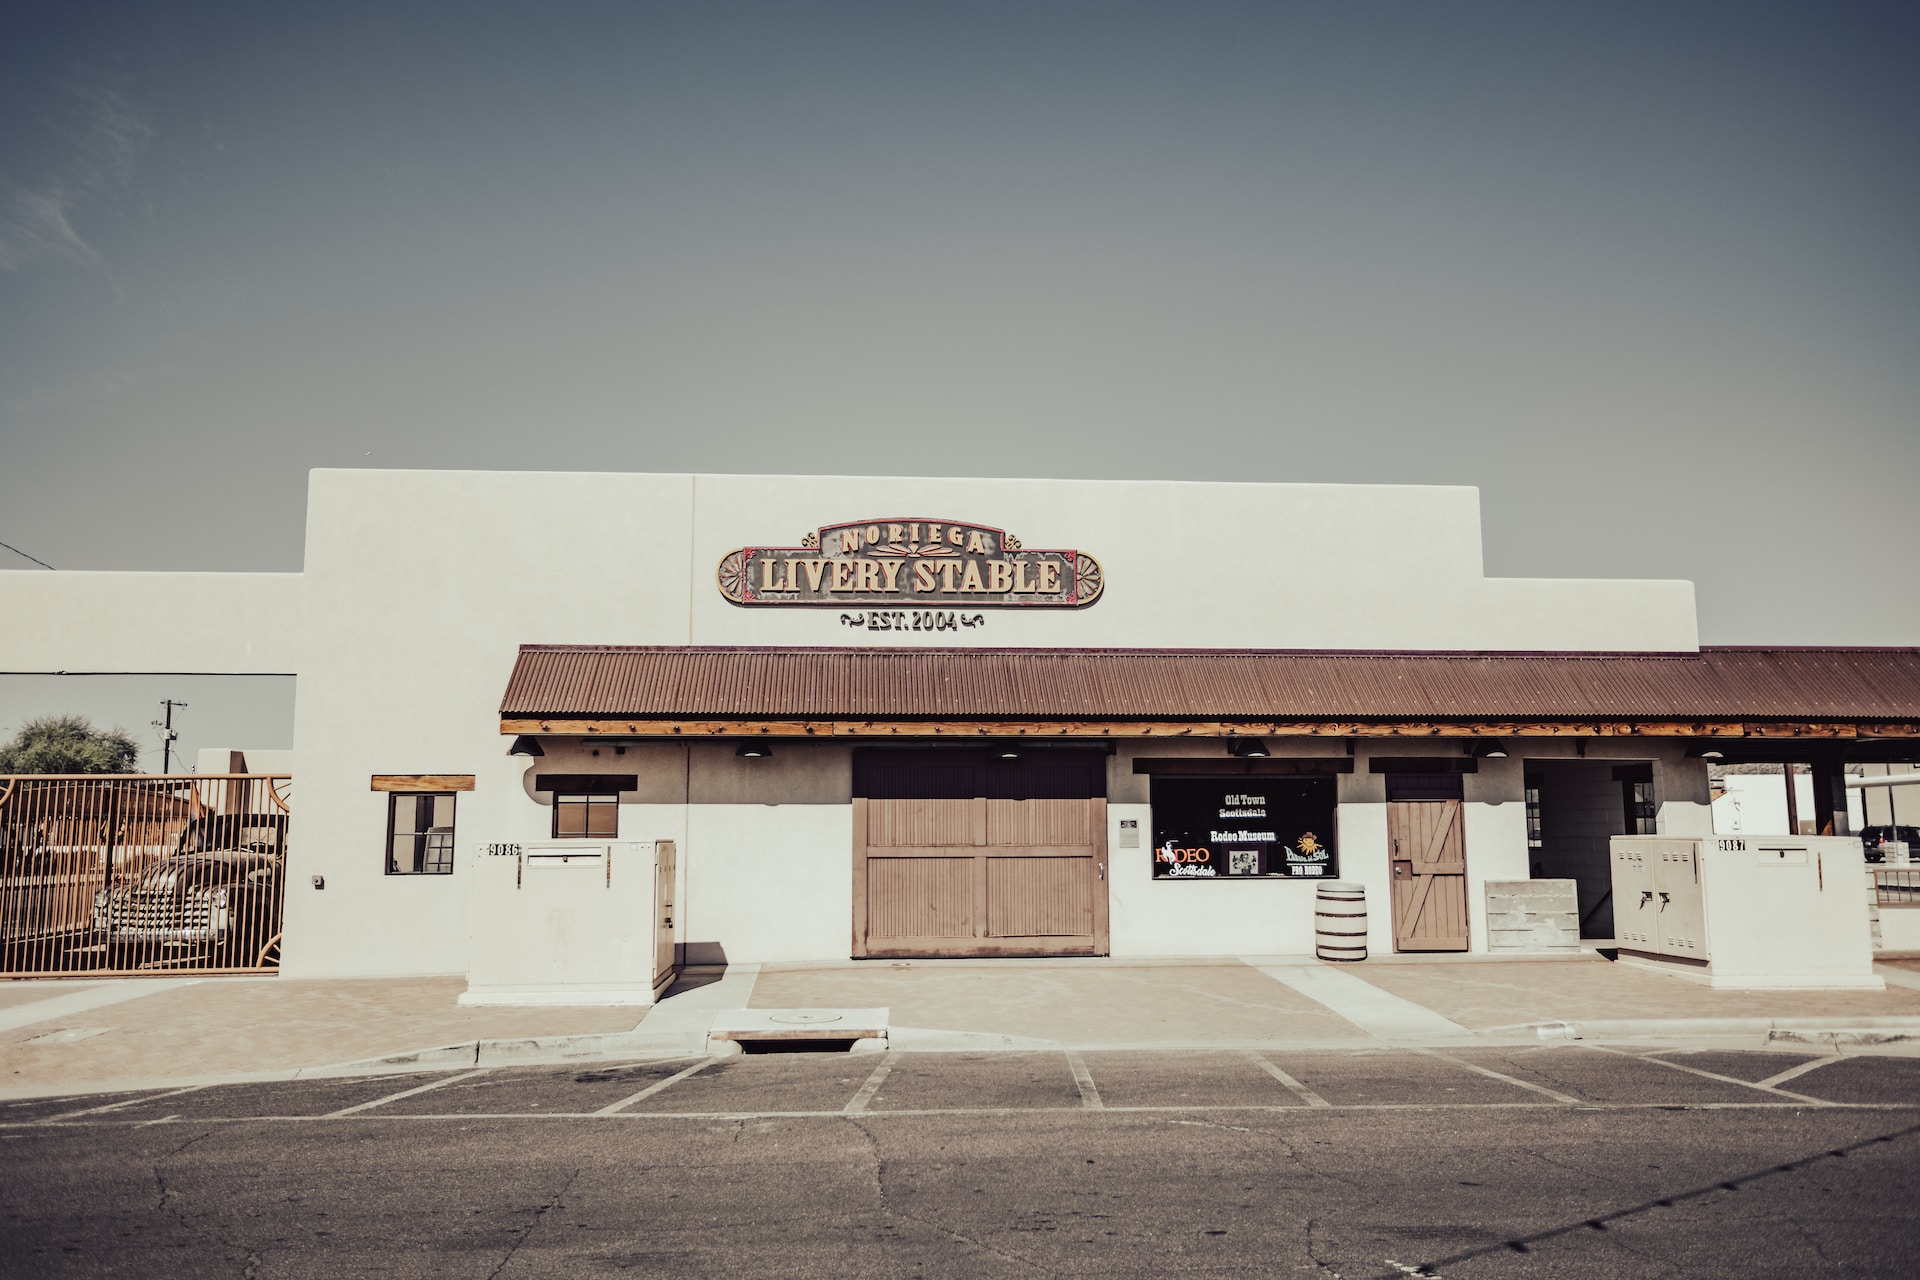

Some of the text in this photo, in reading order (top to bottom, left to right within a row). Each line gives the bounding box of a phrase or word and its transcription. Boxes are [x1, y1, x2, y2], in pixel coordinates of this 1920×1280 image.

[842, 523, 985, 555] NORIEGA
[760, 558, 1060, 594] LIVERY STABLE
[867, 611, 957, 631] EST. 2004
[1225, 794, 1266, 805] Old Town
[1219, 808, 1266, 818] Scottsdale
[1210, 830, 1276, 842] Rodeo Museum
[489, 843, 519, 856] 9086
[1719, 840, 1745, 851] 9087
[1155, 847, 1210, 863] RDEO
